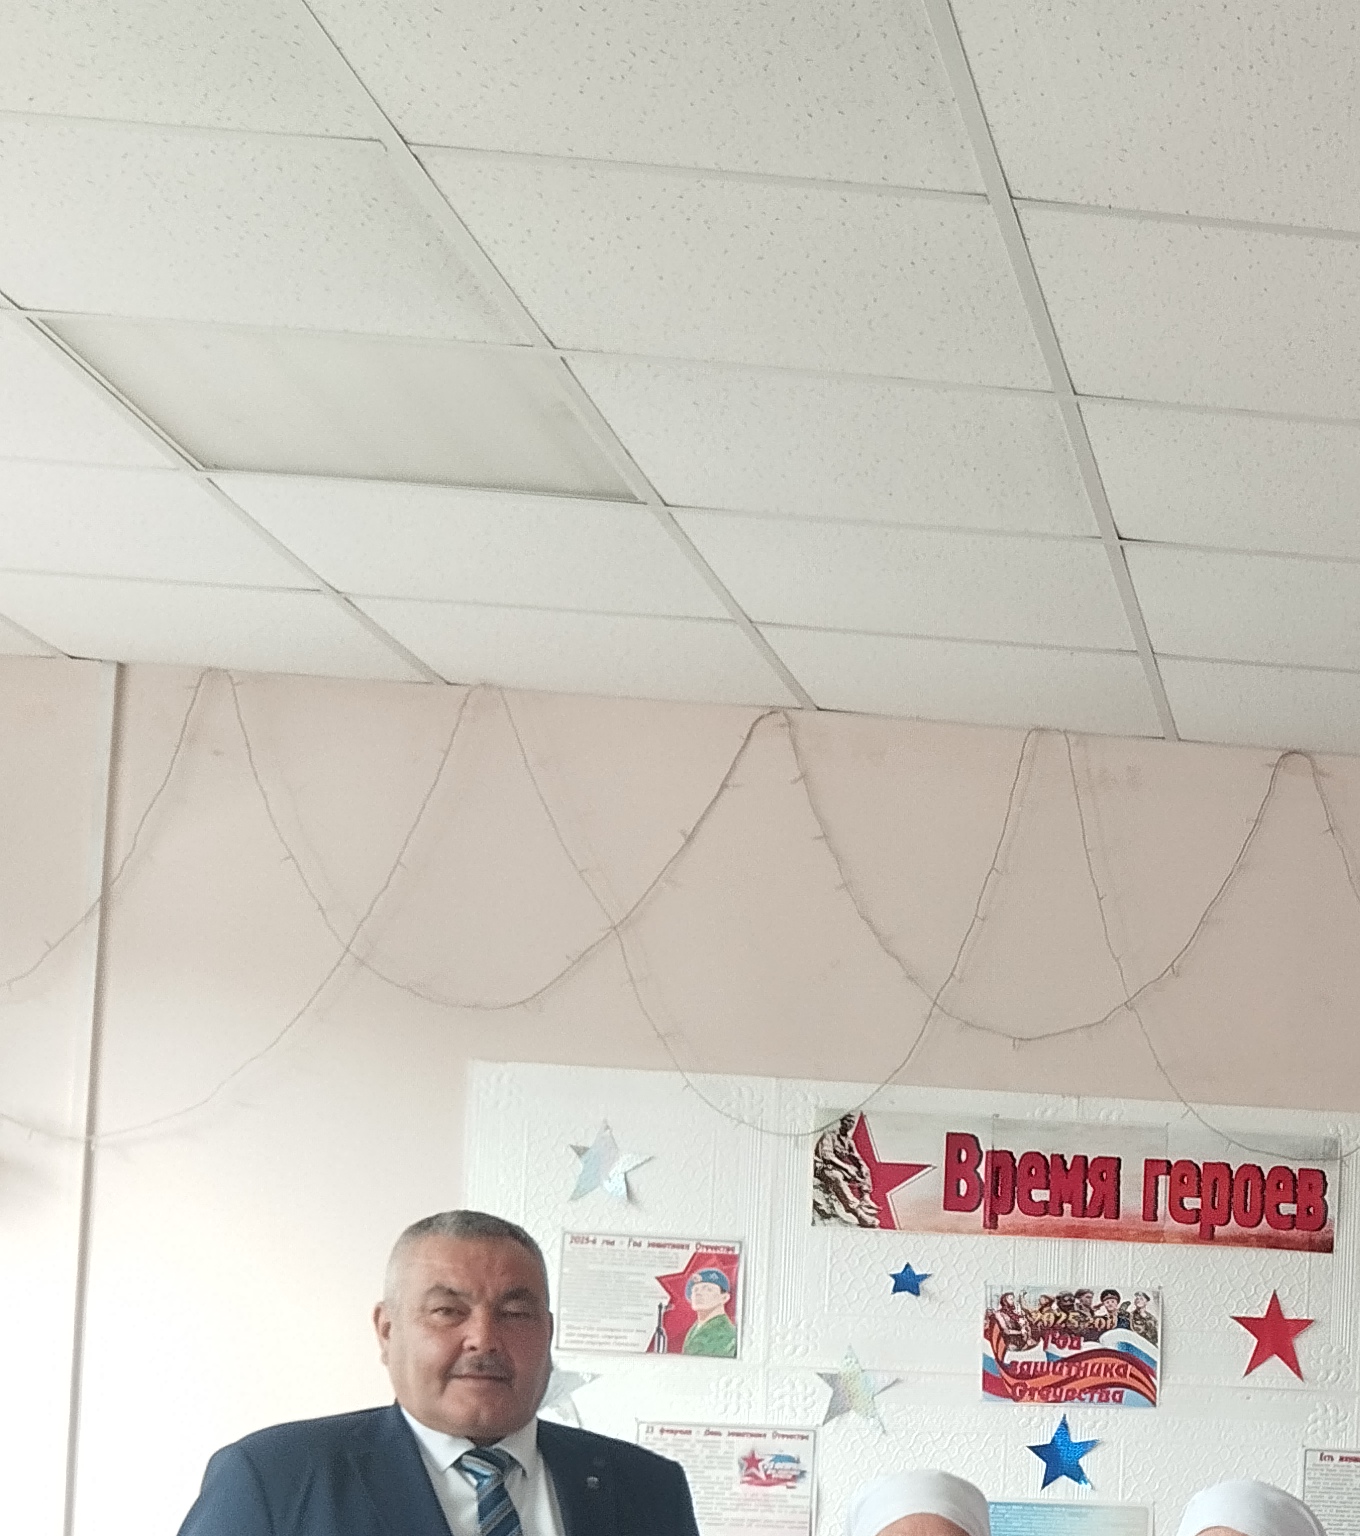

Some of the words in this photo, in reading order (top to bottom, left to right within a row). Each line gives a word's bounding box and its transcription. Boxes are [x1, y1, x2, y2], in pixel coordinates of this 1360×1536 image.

[943, 1132, 1122, 1229] Время
[1142, 1158, 1329, 1240] героев
[1043, 1330, 1082, 1351] Год
[1010, 1361, 1130, 1379] защитника
[1011, 1382, 1124, 1403] Отечества
